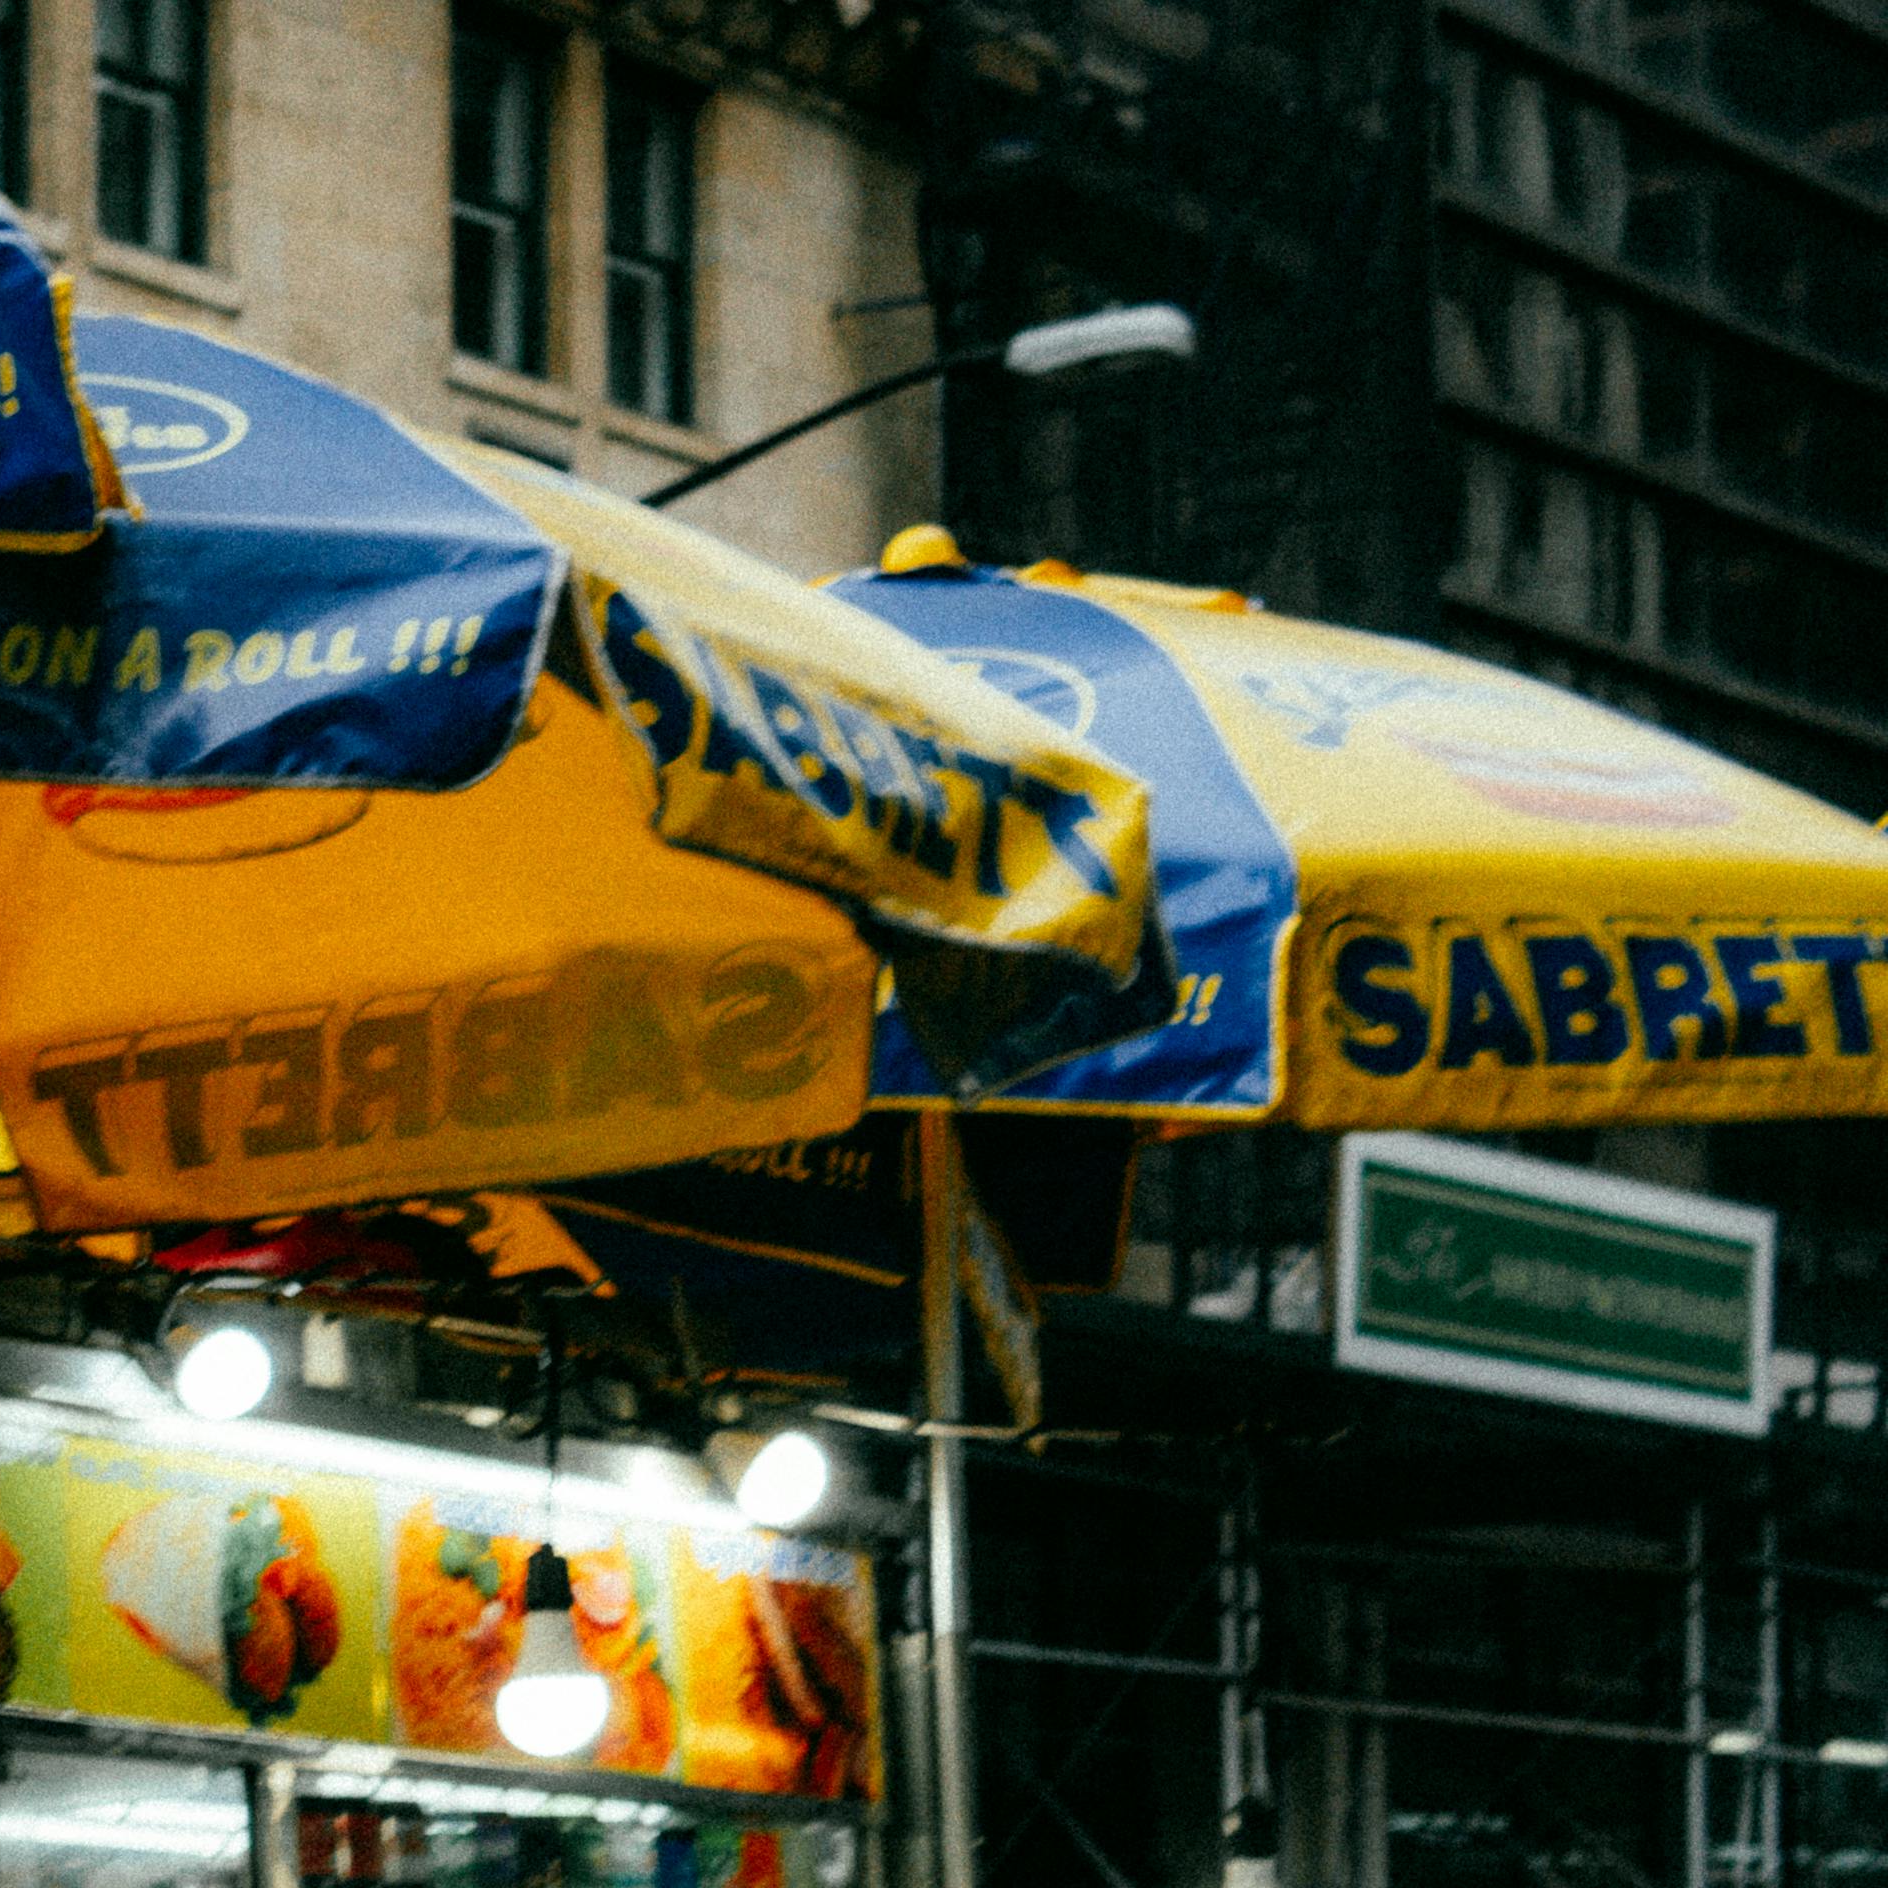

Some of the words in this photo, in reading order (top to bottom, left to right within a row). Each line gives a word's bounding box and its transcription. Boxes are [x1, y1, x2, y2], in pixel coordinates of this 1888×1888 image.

[114, 625, 161, 693] A
[181, 627, 367, 694] ROLL
[387, 614, 485, 678] !!!
[1319, 916, 1888, 1078] SABRET
